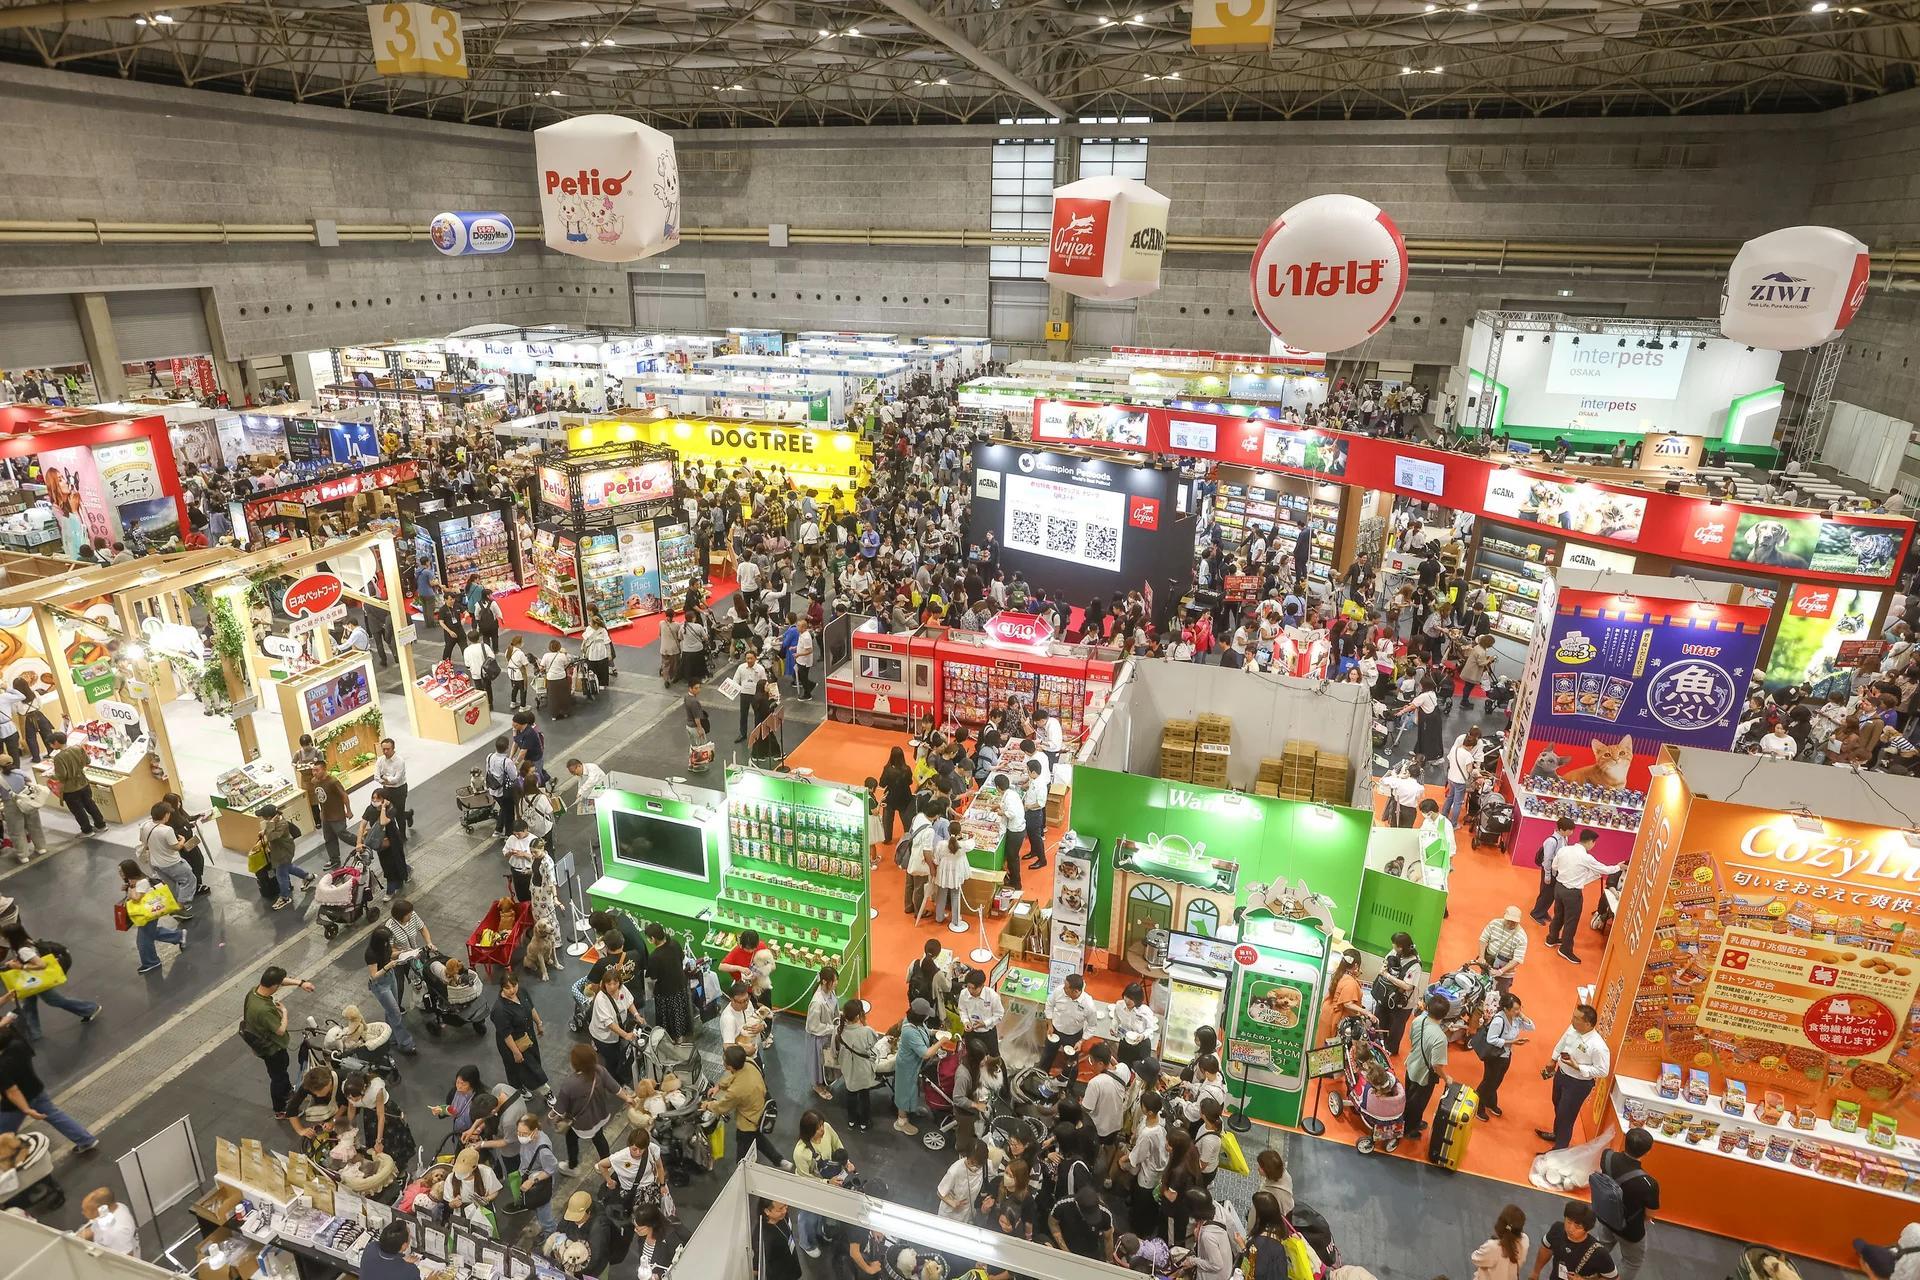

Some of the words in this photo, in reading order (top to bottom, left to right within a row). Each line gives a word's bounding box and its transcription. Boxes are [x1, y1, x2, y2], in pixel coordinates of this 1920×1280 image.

[383, 3, 416, 60] 3
[431, 8, 462, 64] 3
[546, 169, 632, 195] Petio
[473, 231, 508, 241] DoggyMan
[1130, 228, 1166, 251] ACAN
[1268, 259, 1388, 297] いなば
[1749, 285, 1812, 302] ZIWI
[344, 354, 379, 362] DoggyMan
[405, 357, 440, 365] DoggyMan
[1573, 346, 1664, 367] interpets
[1569, 368, 1600, 377] OSAKA
[1581, 397, 1637, 412] interpets
[711, 429, 814, 453] DOGTREE
[1654, 442, 1691, 456] ZIWI
[321, 478, 358, 499] Petio
[543, 479, 566, 498] Petio
[603, 475, 657, 497] Petio
[977, 478, 998, 488] ACANA
[1491, 487, 1514, 499] ACANA
[1569, 554, 1596, 567] ACANA
[289, 582, 339, 608] 日本ペットフード
[999, 622, 1034, 637] CIAO
[279, 643, 296, 654] CAT
[1681, 644, 1721, 658] いなば
[871, 682, 892, 692] CIAO
[1669, 664, 1715, 705] 魚
[111, 708, 133, 720] DOG
[1662, 703, 1711, 720] づくし
[288, 813, 301, 823] re
[1674, 885, 1711, 896] CozyLife
[1738, 904, 1767, 912] CozyLife
[1648, 950, 1674, 960] ozyLife
[1719, 974, 1775, 991] キトサン配合
[1709, 1000, 1789, 1022] 緑茶消臭成分配合
[1821, 1014, 1877, 1026] キトサンの
[1808, 1024, 1889, 1038] 食物繊維が匂いを
[1241, 1031, 1300, 1048] あなたのワンちゃんと
[1819, 1034, 1878, 1047] 吸着します。
